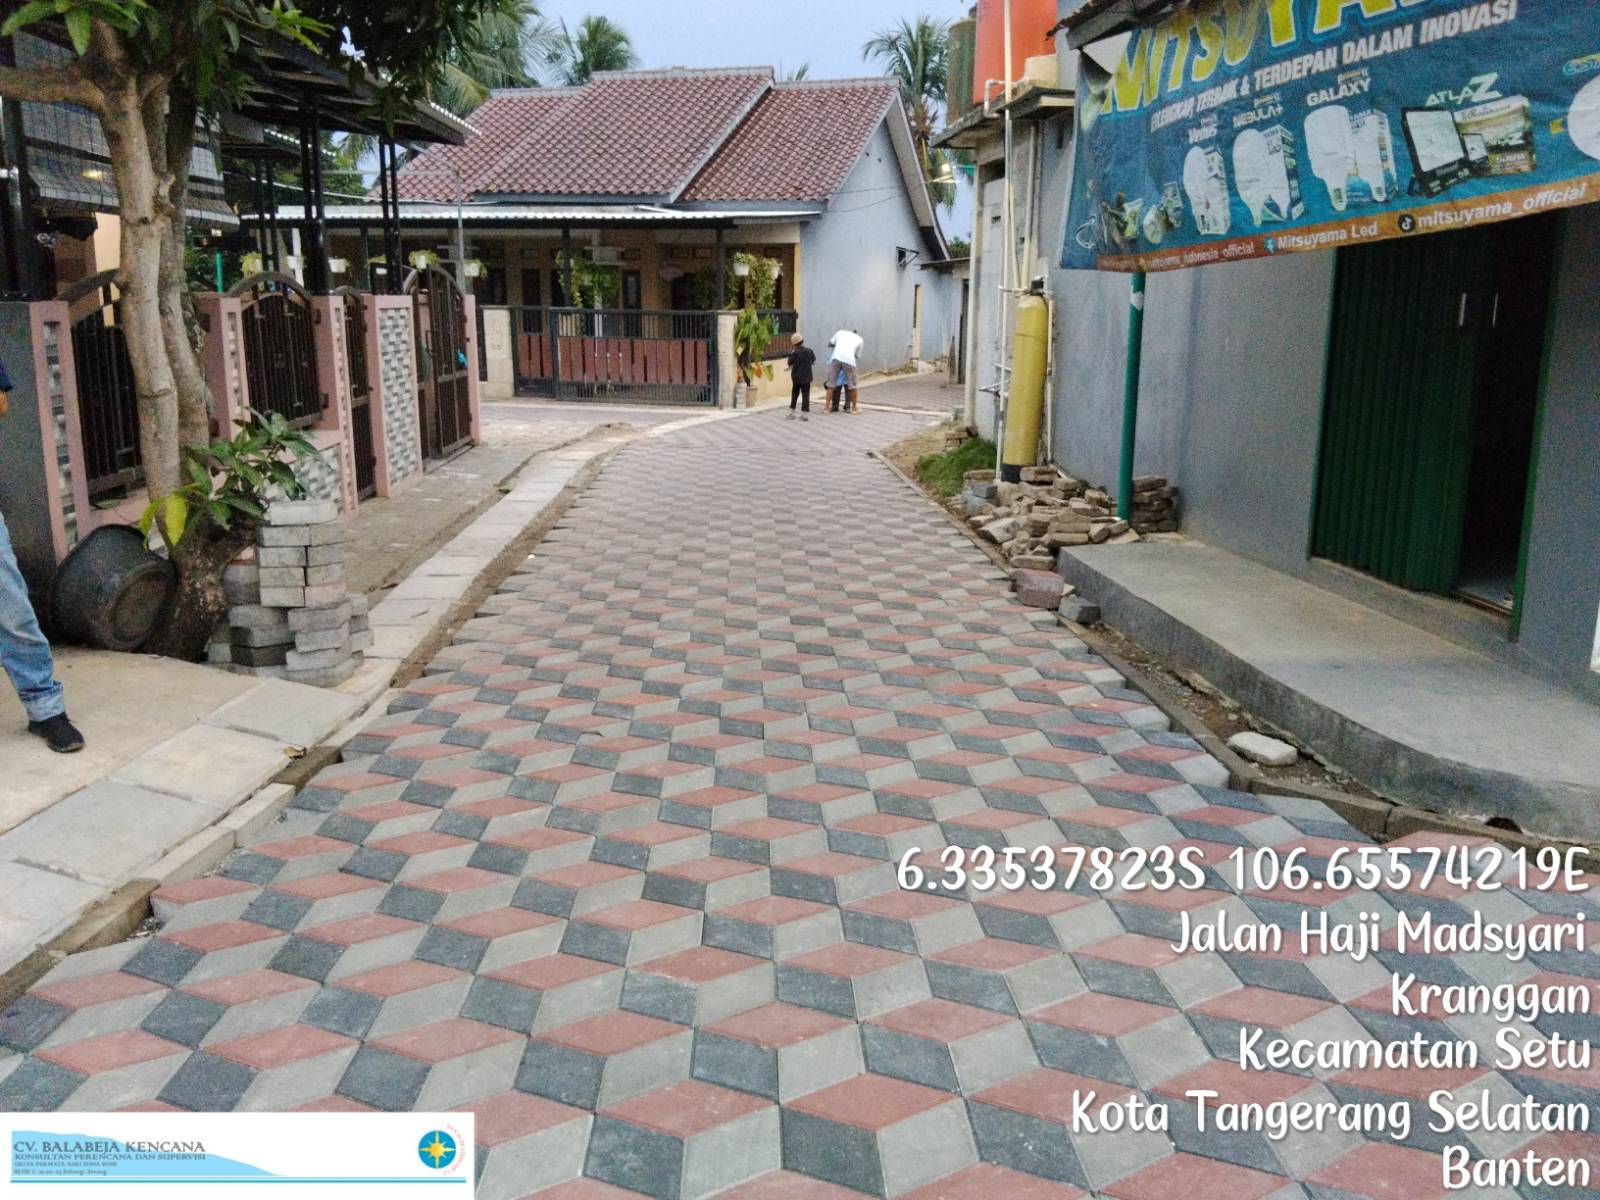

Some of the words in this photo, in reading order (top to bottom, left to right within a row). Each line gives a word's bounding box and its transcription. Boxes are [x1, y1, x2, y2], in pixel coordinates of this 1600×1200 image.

[1100, 0, 1428, 114] MITSUY
[1240, 74, 1250, 96] &
[1254, 46, 1338, 91] TERDEPAN
[1342, 24, 1414, 65] DALAM
[1420, 0, 1518, 44] INOVASI
[1306, 77, 1372, 106] GALAXY
[1418, 183, 1587, 231] mitsuyama_official
[1278, 228, 1347, 249] Mitsuyama
[1351, 223, 1378, 238] Led
